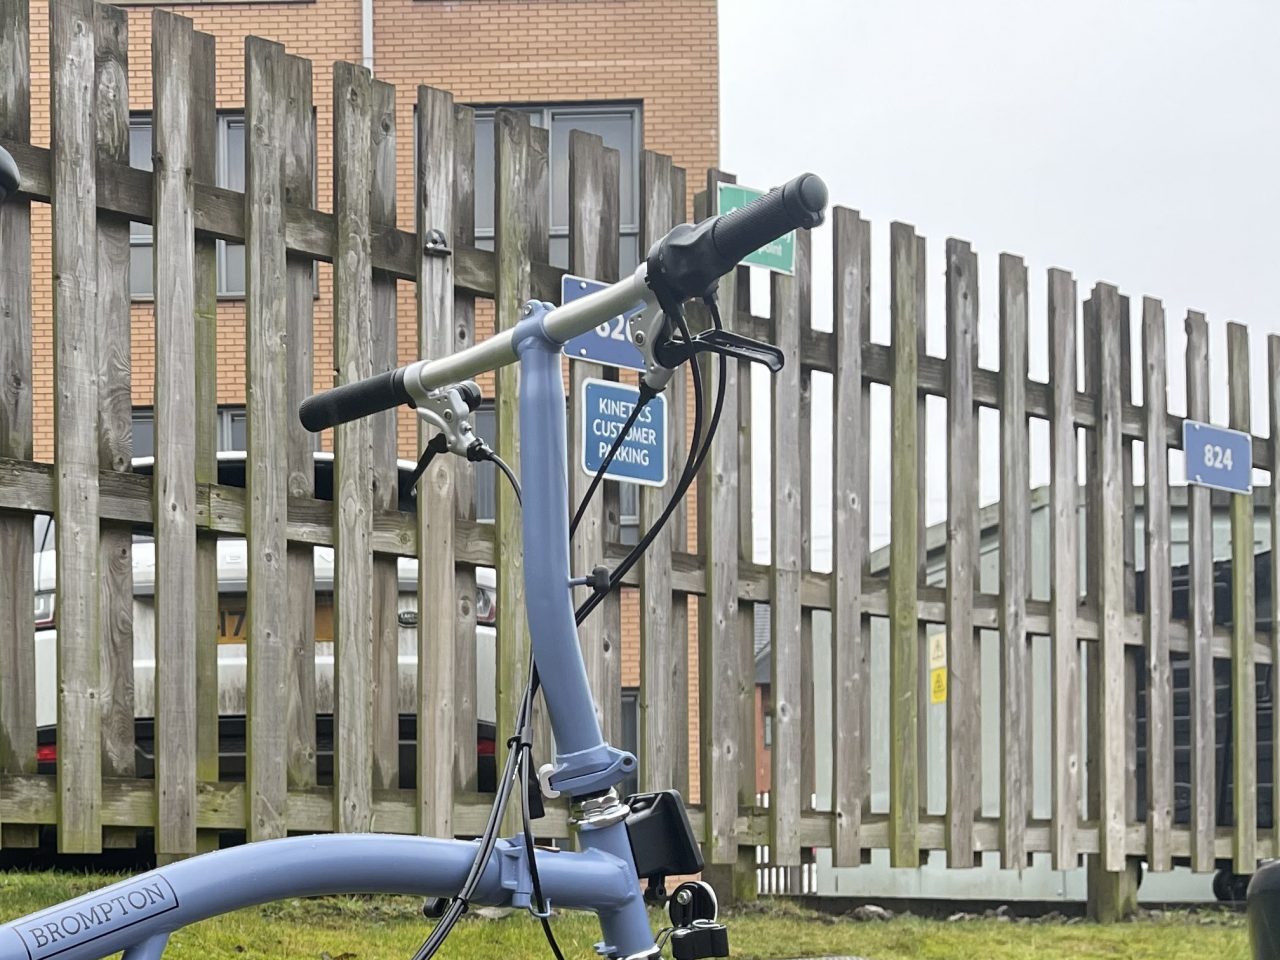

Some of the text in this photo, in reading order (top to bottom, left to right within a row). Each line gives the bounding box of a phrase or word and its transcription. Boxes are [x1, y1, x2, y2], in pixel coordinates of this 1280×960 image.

[599, 397, 652, 423] KINETCS
[1204, 444, 1233, 471] 824
[29, 883, 166, 948] BROMPTON
